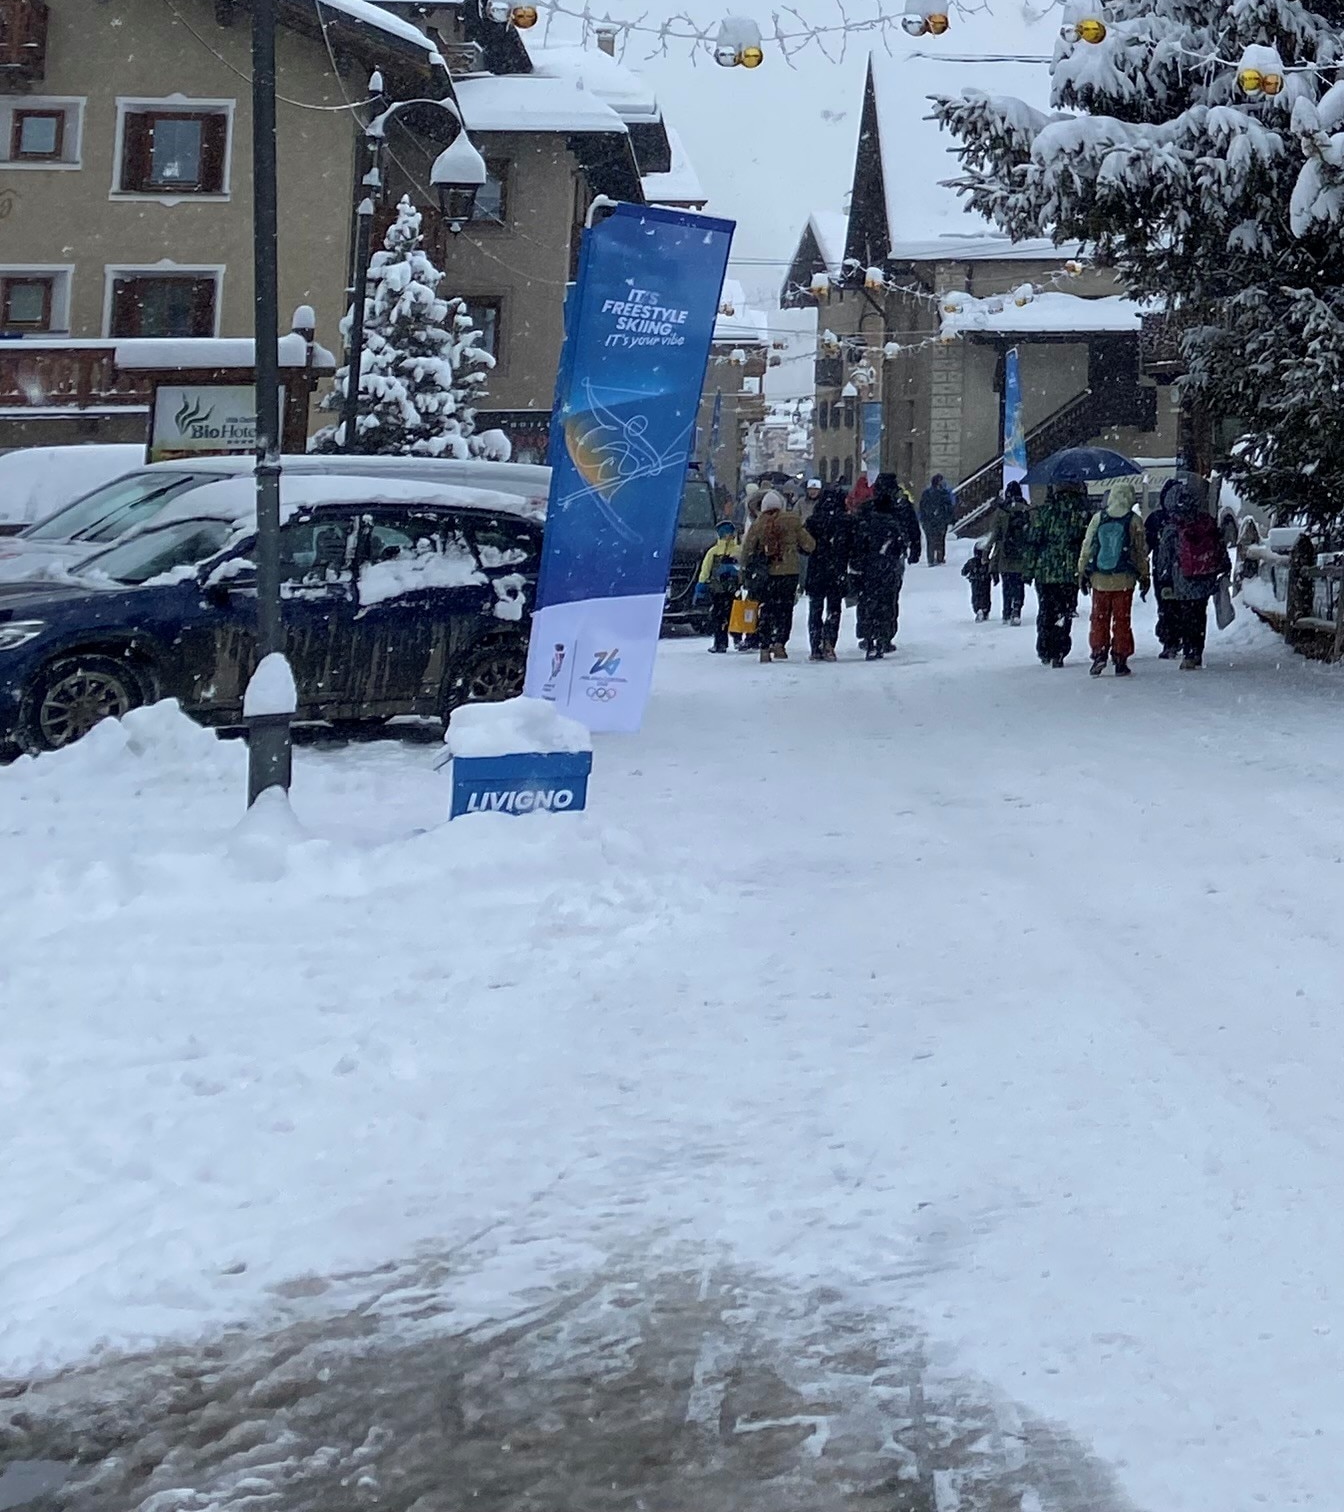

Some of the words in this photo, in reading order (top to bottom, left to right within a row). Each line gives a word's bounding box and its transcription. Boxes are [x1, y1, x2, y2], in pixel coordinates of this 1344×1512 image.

[628, 288, 660, 306] IT'S
[601, 299, 689, 324] FREESTYLE
[616, 316, 673, 336] SKIING
[628, 335, 660, 348] your
[661, 332, 685, 346] vibe
[466, 789, 574, 812] LIVIGNO
